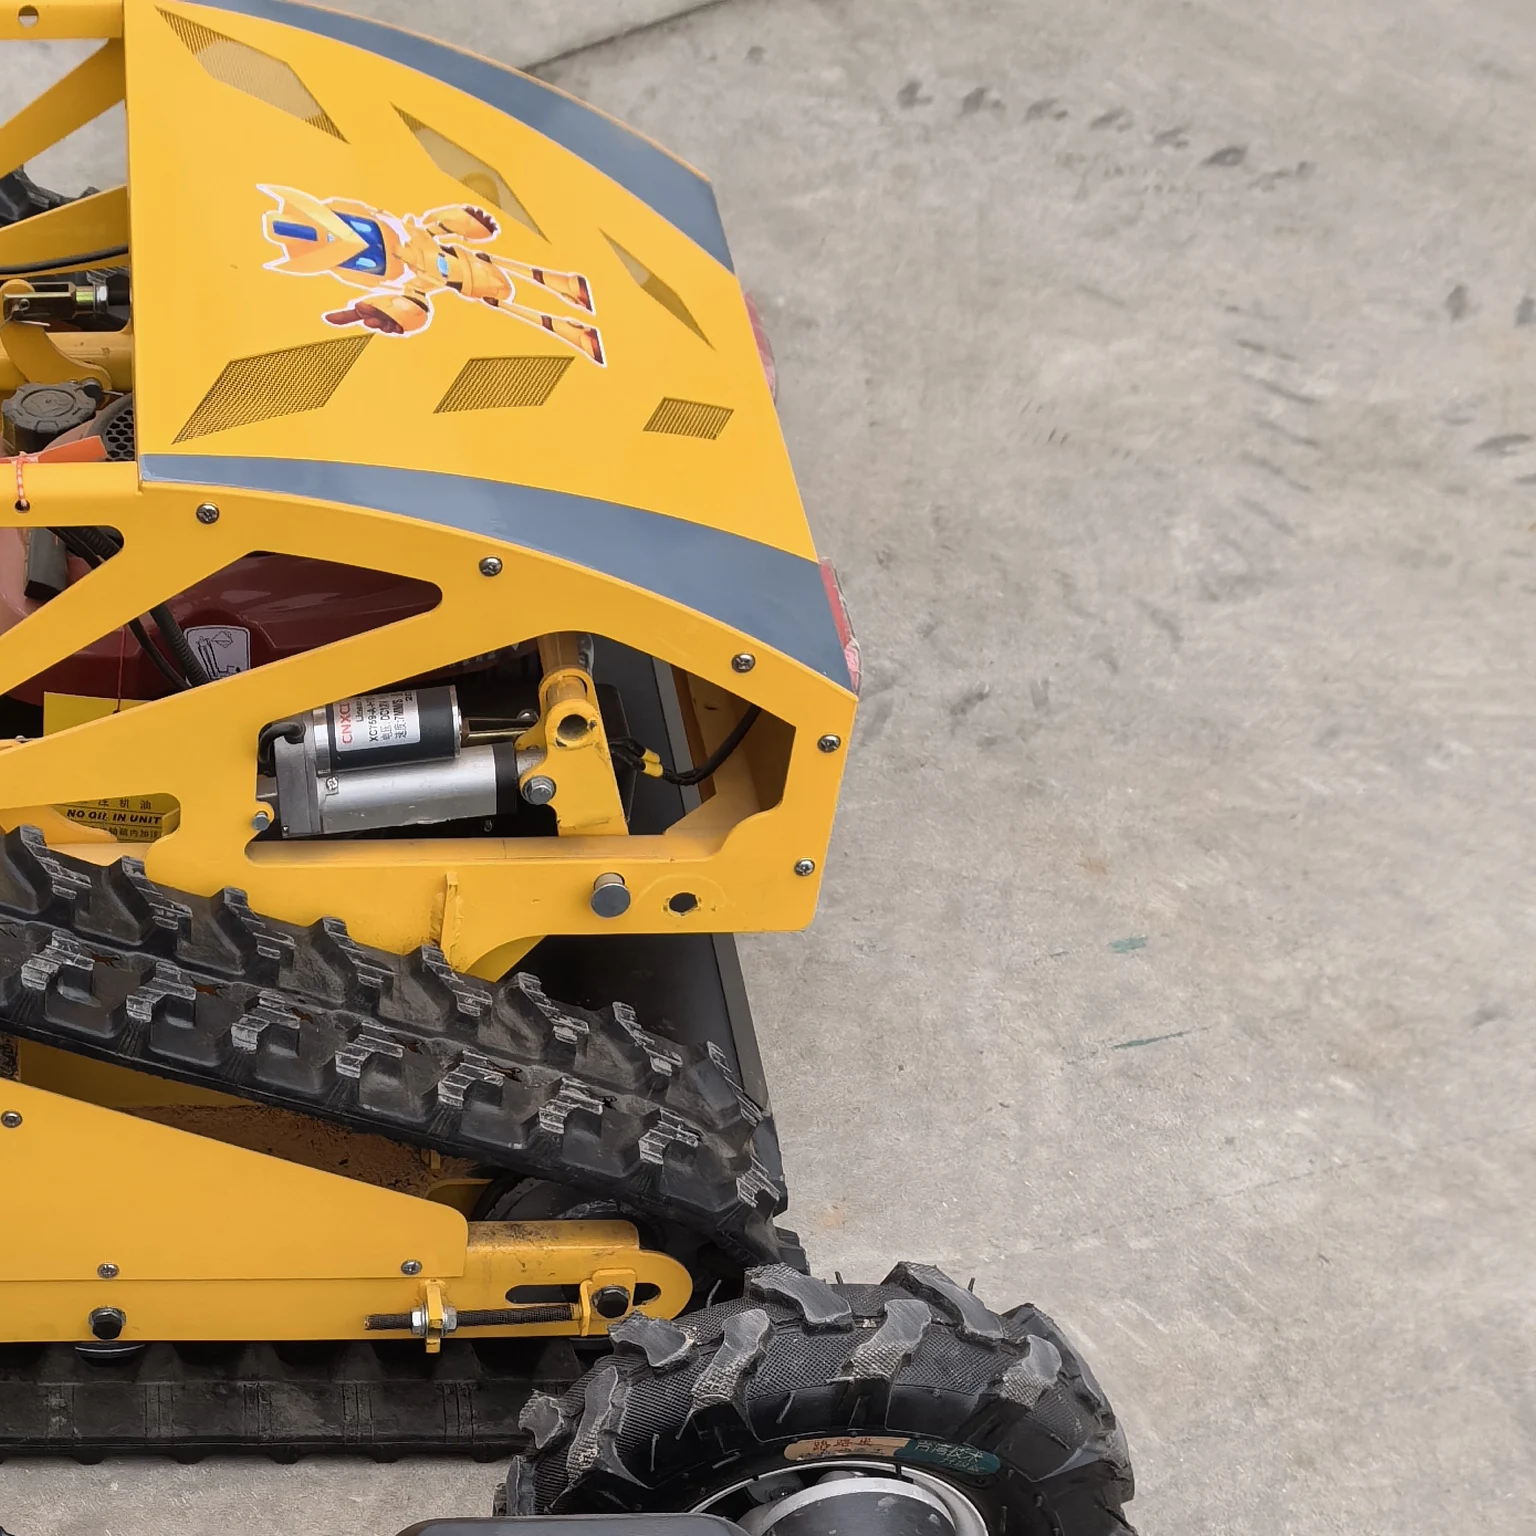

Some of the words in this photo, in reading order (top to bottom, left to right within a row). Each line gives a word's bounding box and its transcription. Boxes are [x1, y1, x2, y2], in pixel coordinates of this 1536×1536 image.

[66, 809, 85, 818] NO
[88, 811, 109, 821] OIL
[113, 814, 127, 822] IN
[129, 815, 162, 825] UNIT
